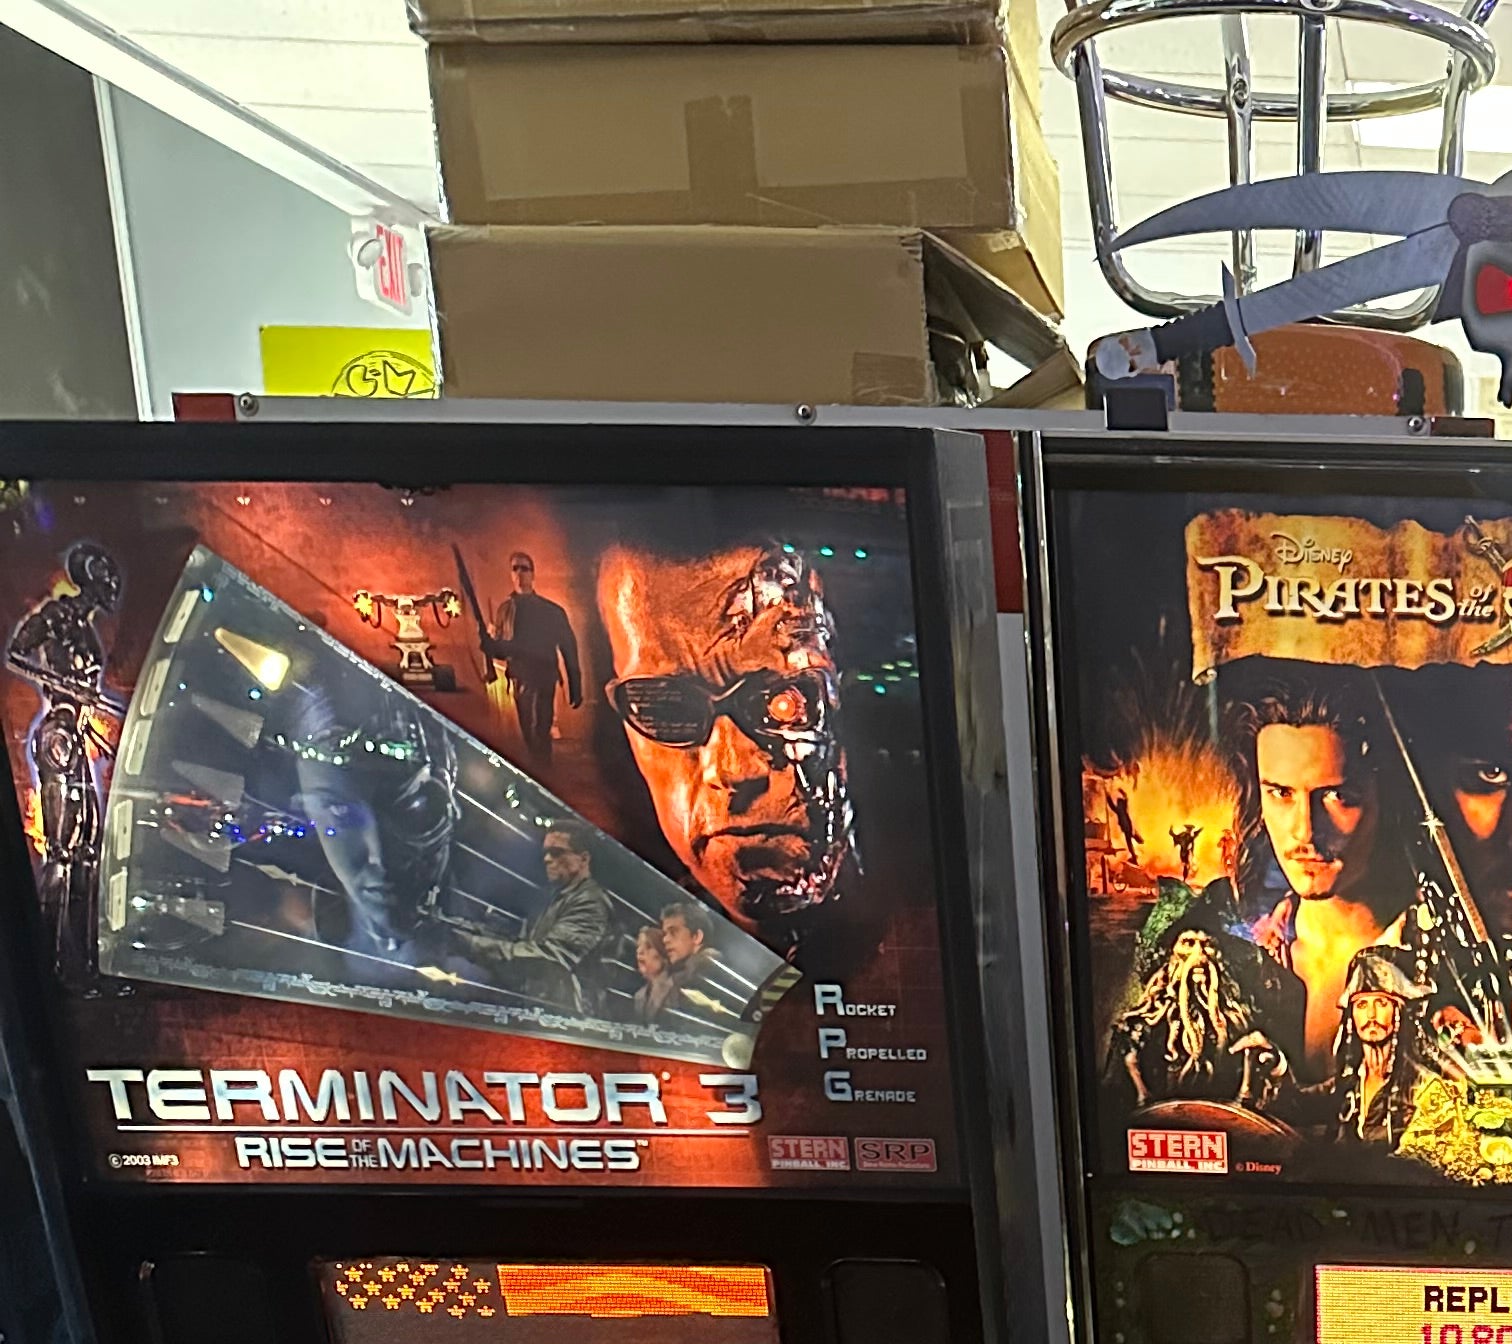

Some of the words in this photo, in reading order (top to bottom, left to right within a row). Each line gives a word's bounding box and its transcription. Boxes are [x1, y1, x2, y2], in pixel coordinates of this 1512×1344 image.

[1195, 555, 1456, 622] PIRATES
[1469, 584, 1495, 602] of
[1458, 599, 1494, 618] the
[814, 984, 897, 1017] ROCKET
[818, 1028, 927, 1060] PROPELLED
[86, 1069, 669, 1124] TERMINATOR
[699, 1073, 763, 1125] 3
[824, 1071, 916, 1102] GRENADE
[235, 1136, 349, 1168] RISE
[352, 1139, 371, 1151] OF
[771, 1138, 847, 1158] STERN
[861, 1142, 931, 1161] SRP
[1132, 1133, 1223, 1159] STERN
[350, 1154, 378, 1168] THE
[1245, 1161, 1283, 1175] Disney
[1360, 1209, 1460, 1250] MEN
